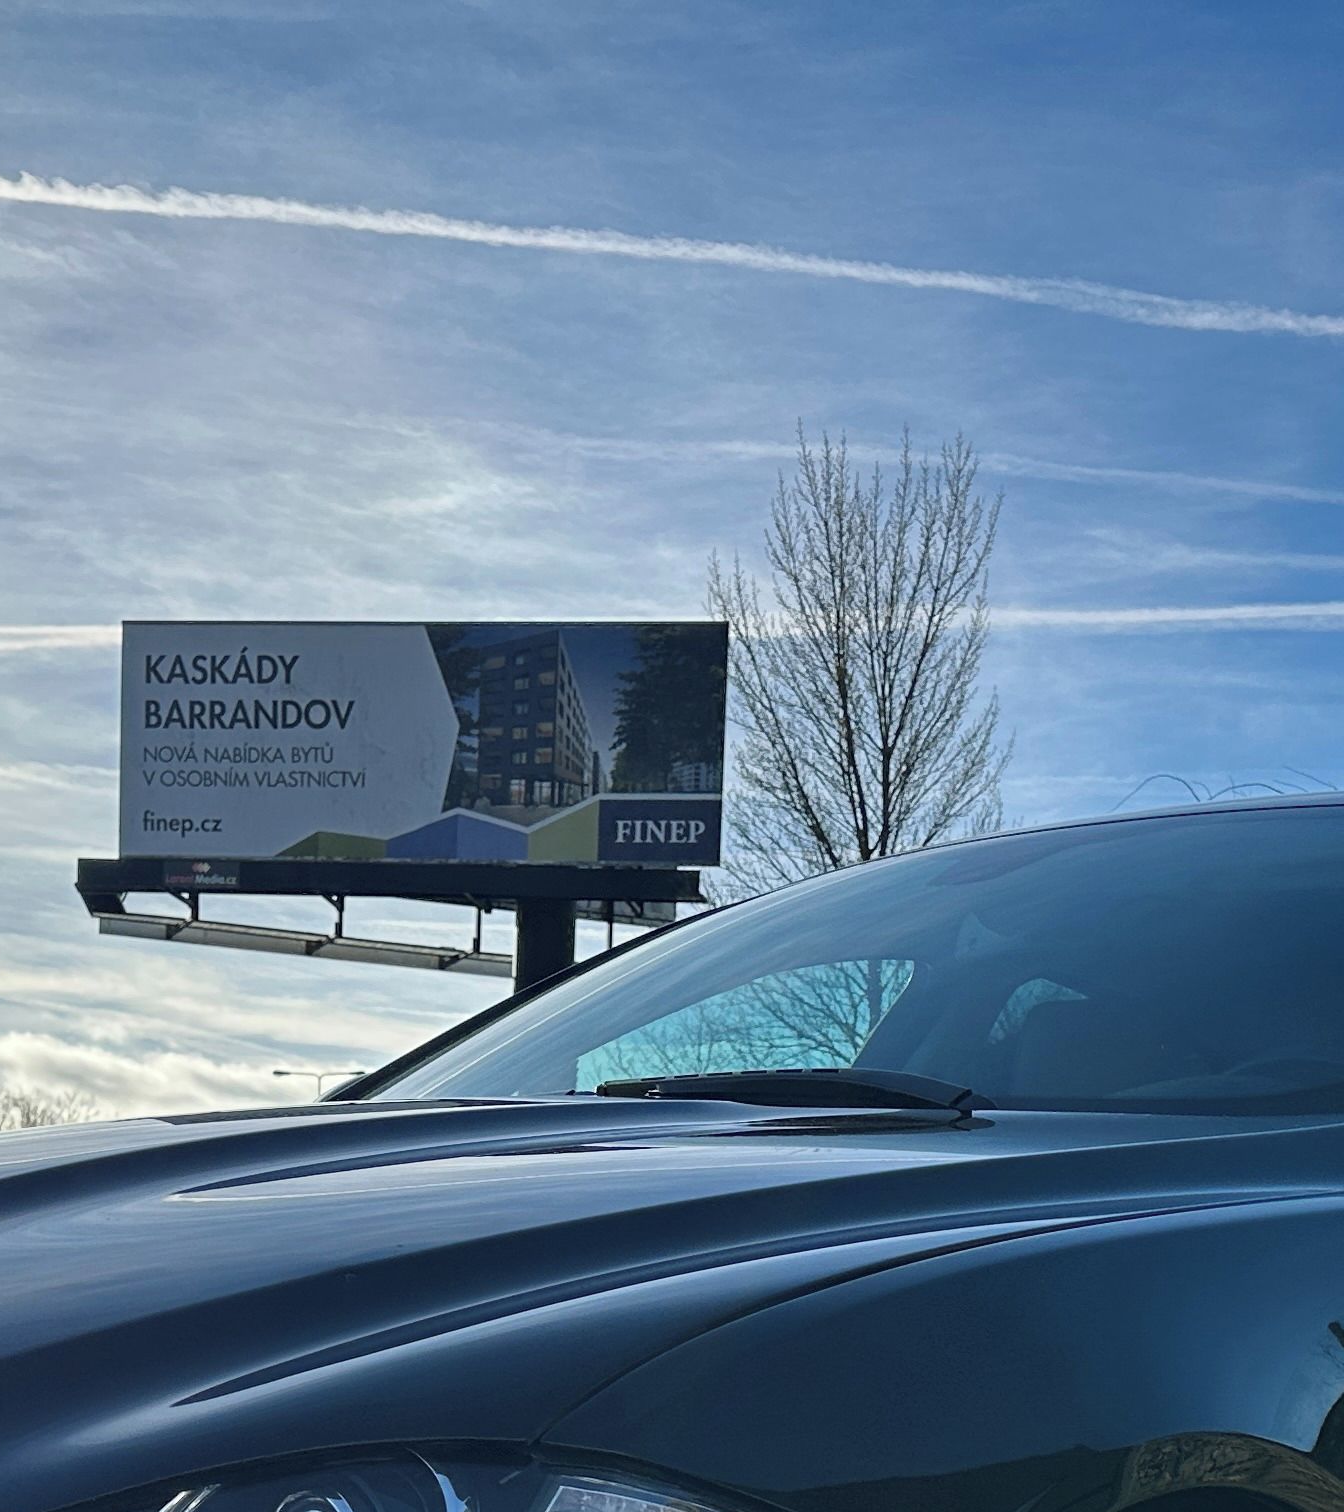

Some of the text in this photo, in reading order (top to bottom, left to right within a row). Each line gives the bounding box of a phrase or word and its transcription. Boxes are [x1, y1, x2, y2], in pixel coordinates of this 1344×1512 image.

[144, 645, 300, 685] KASKÁDY
[144, 698, 355, 730] BARRANDOV
[143, 742, 334, 764] NOVÁ NABÍDKA BYTŮ
[142, 767, 367, 788] V OSOBNÍM VLASTNICTVÍ
[143, 810, 223, 838] finep.cz
[615, 819, 706, 844] FINEP
